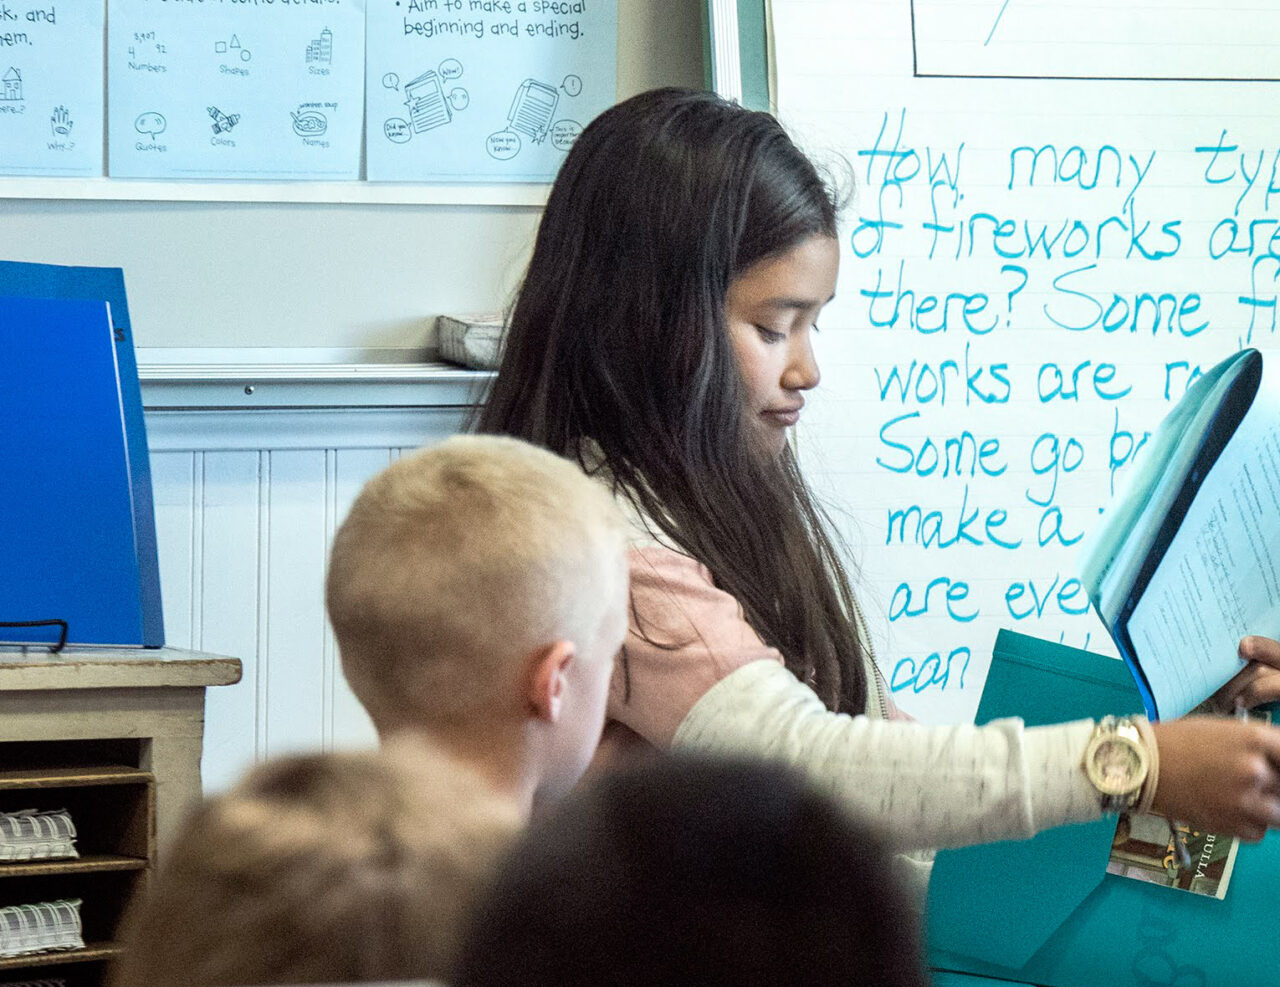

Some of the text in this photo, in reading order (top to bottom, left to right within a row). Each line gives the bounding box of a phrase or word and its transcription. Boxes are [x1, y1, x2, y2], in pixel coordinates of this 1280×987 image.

[25, 6, 56, 24] and
[403, 17, 585, 39] beginning and ending.
[517, 2, 527, 12] a
[858, 107, 964, 187] How
[1008, 143, 1157, 214] many
[851, 179, 903, 258] of
[922, 179, 1182, 260] fireworks
[860, 260, 1028, 335] there?
[1043, 264, 1210, 332] Some
[874, 341, 1011, 406] works
[1037, 361, 1133, 402] are
[876, 411, 1008, 478] Some
[1025, 432, 1085, 507] go
[886, 484, 1024, 549] make
[1038, 505, 1085, 548] a
[889, 576, 980, 622] are
[890, 646, 971, 694] can
[1193, 833, 1217, 880] BULLA
